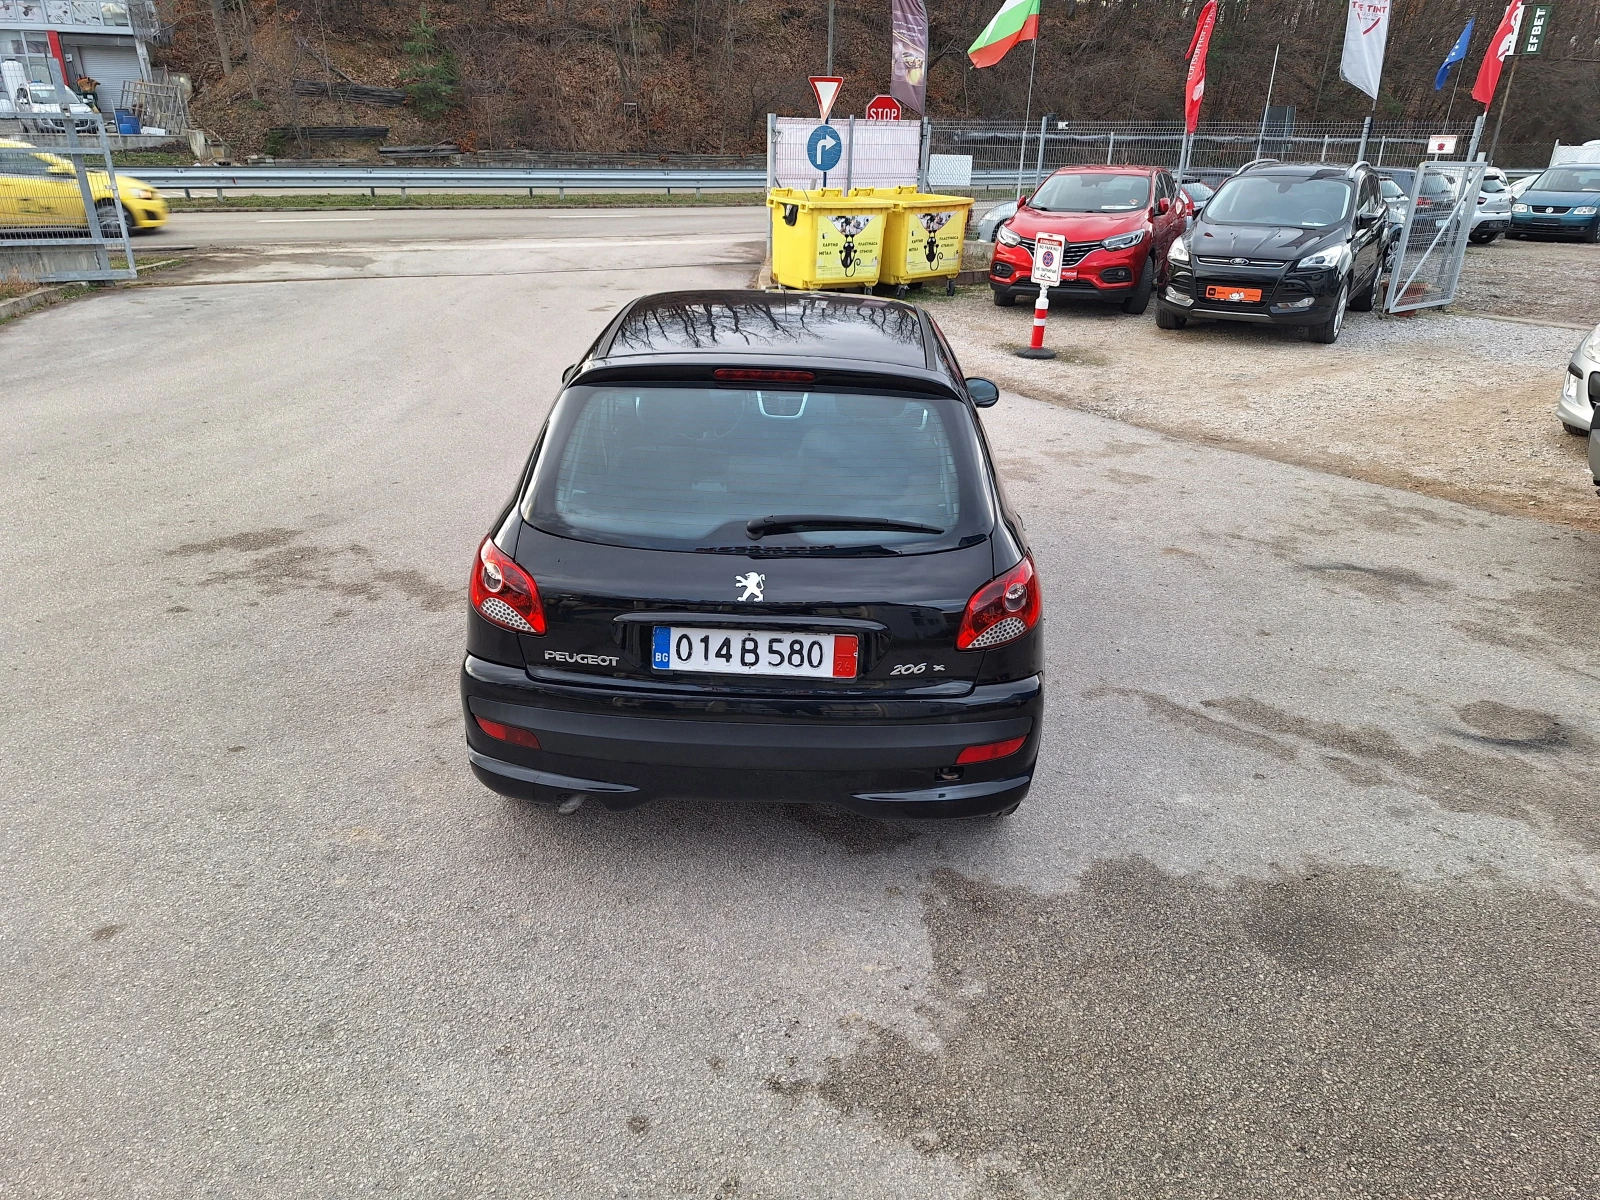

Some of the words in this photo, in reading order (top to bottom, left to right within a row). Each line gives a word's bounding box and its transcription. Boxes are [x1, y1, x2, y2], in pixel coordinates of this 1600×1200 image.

[1367, 4, 1387, 14] TINT
[1526, 7, 1547, 52] EFBET
[870, 108, 898, 121] STOP
[544, 650, 620, 667] PEUGEOT
[655, 651, 669, 662] BG
[889, 661, 928, 676] 206
